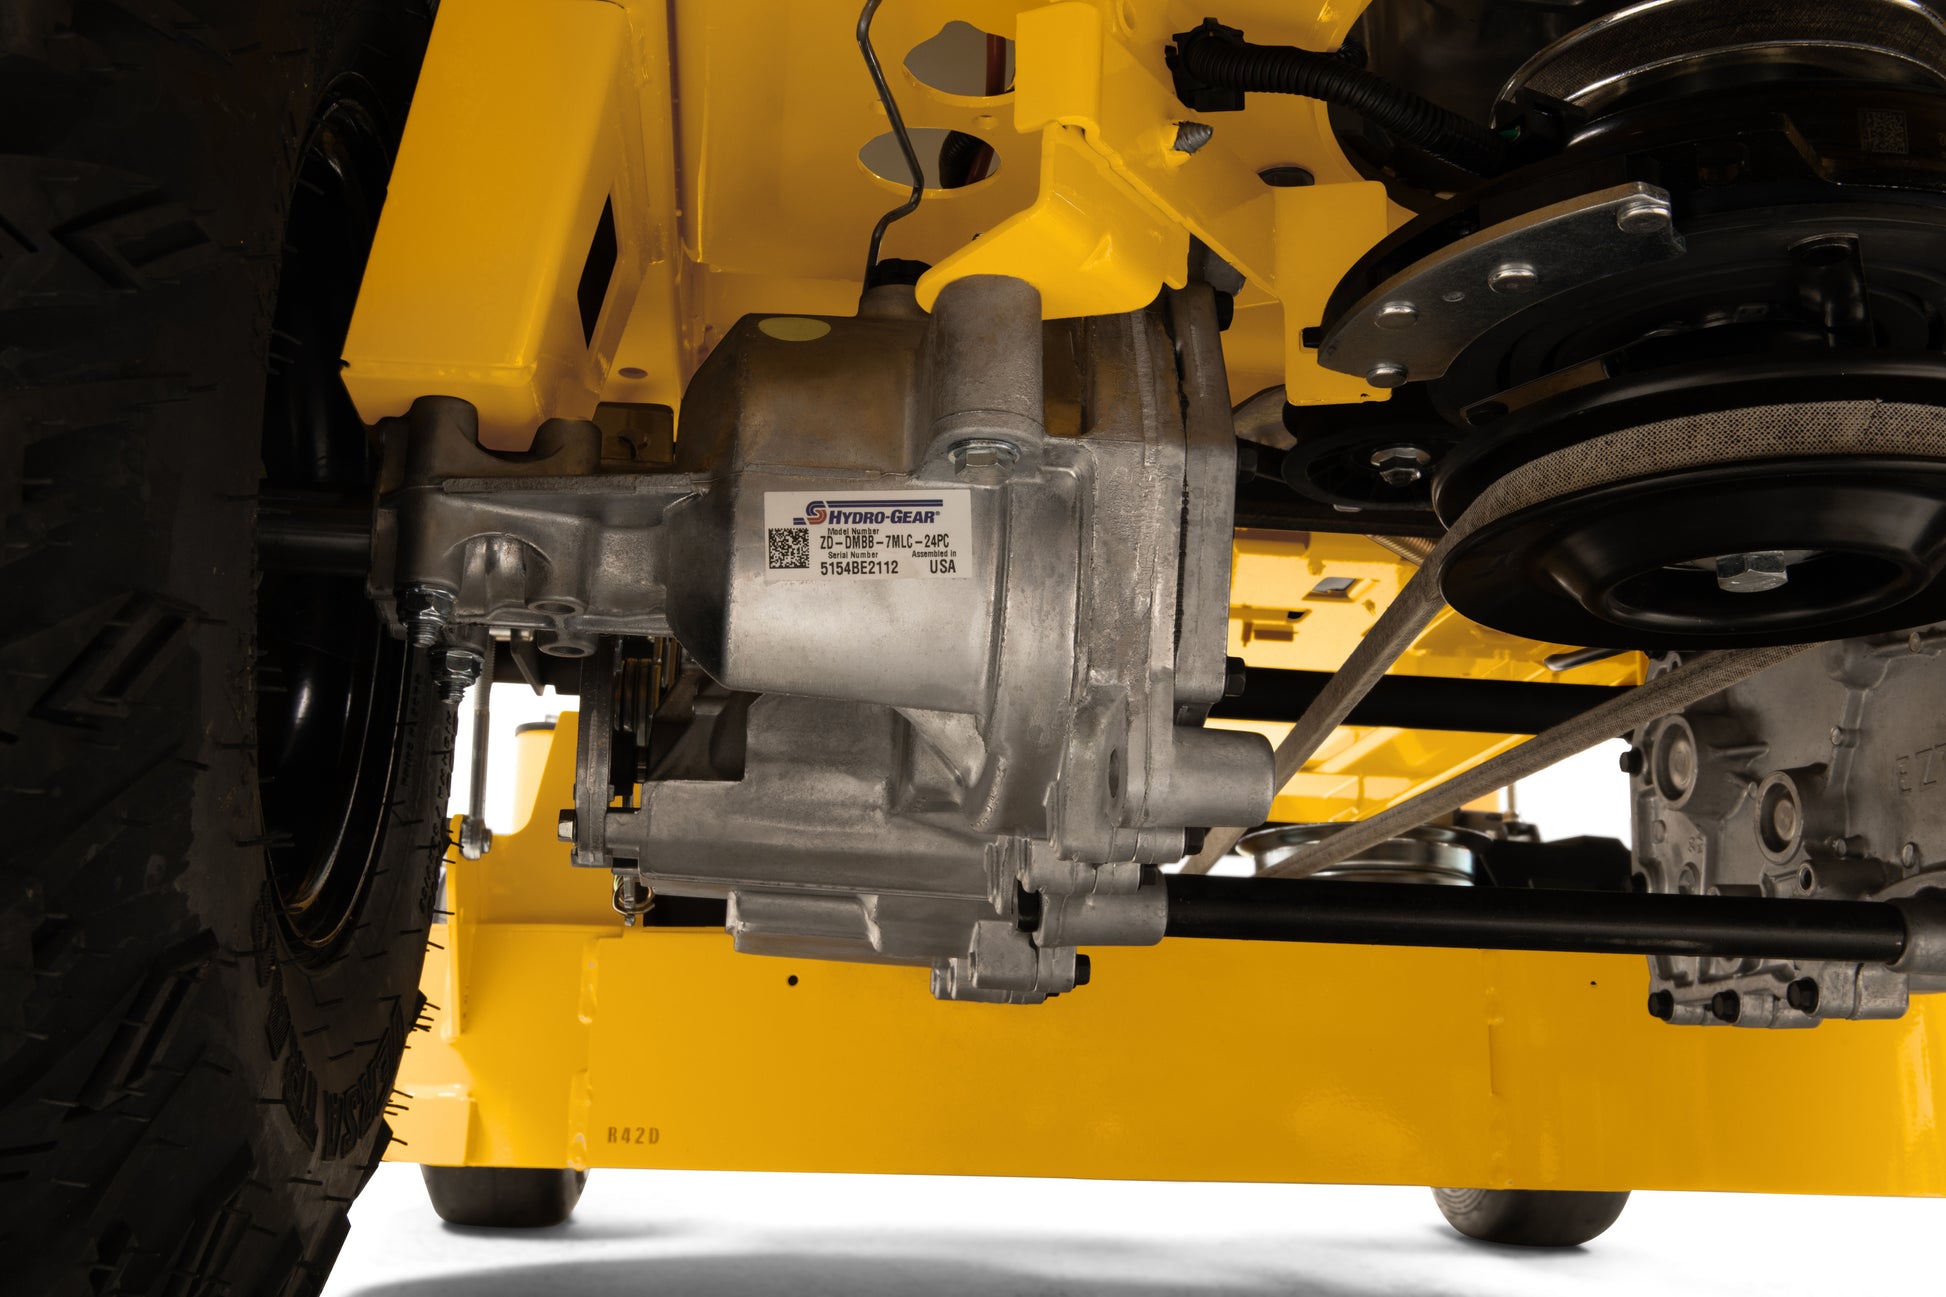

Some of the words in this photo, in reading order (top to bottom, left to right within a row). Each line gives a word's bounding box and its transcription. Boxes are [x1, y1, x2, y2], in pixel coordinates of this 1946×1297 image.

[828, 527, 850, 535] Model
[851, 527, 880, 535] Number
[828, 551, 849, 559] Serial
[850, 551, 879, 559] Number
[911, 549, 949, 558] Assembled
[950, 549, 957, 557] in
[820, 560, 899, 576] 5154BE2112
[929, 559, 956, 574] USA
[607, 1126, 660, 1145] R42D
